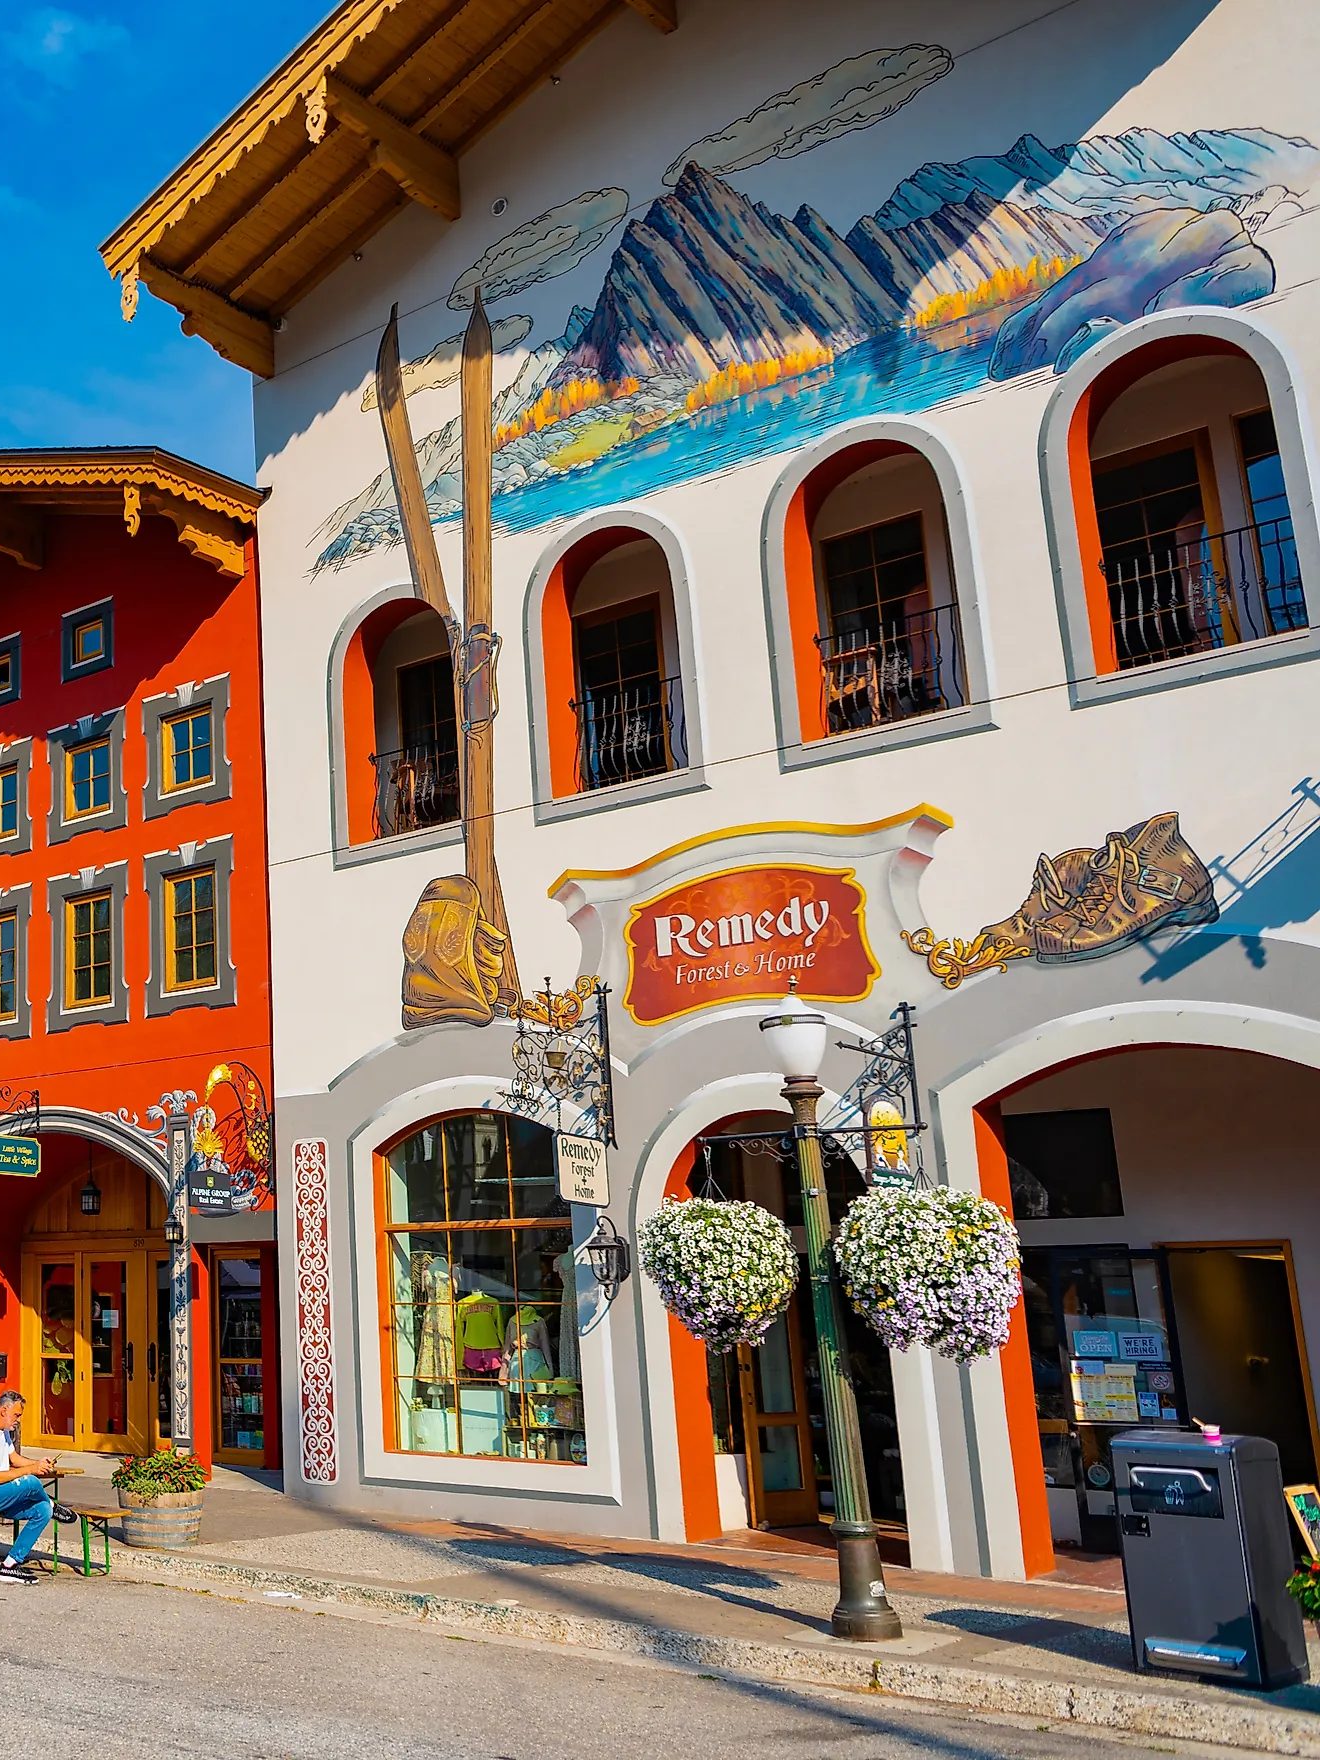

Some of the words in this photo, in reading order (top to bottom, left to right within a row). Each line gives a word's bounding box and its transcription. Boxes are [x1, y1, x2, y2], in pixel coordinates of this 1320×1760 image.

[654, 896, 829, 957] Remedy
[676, 960, 730, 985] Forest
[733, 962, 750, 976] &
[753, 950, 816, 976] Home
[561, 1137, 601, 1166] Remedy
[0, 1154, 12, 1163] Tea
[12, 1154, 21, 1164] &
[20, 1156, 37, 1167] Spice
[571, 1161, 595, 1178] Forest
[191, 1187, 211, 1196] ALPINE
[211, 1189, 231, 1198] GROUP
[574, 1183, 595, 1199] Home
[1080, 1344, 1112, 1353] OPEN
[1124, 1339, 1155, 1347] WE'RE
[1126, 1346, 1158, 1354] HIRING!
